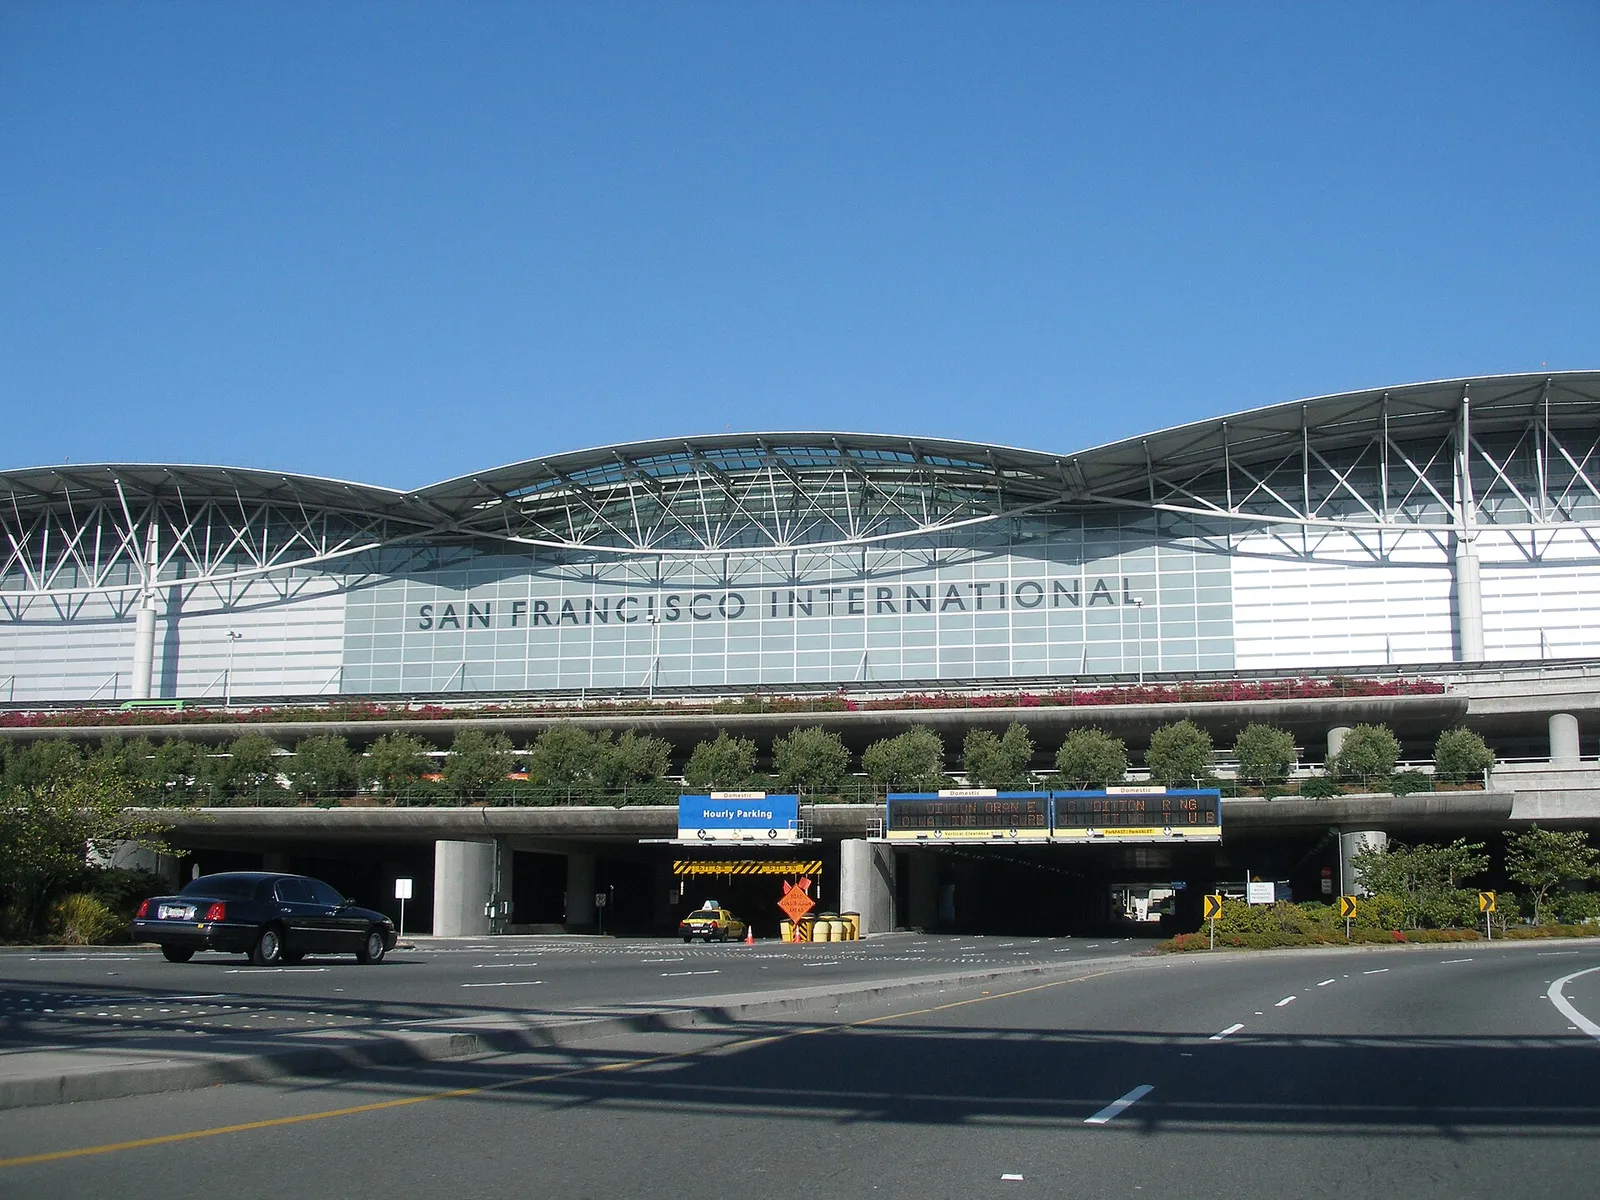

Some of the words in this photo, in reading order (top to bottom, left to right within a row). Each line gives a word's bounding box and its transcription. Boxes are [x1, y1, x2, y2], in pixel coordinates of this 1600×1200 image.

[419, 602, 490, 630] SAN
[512, 593, 746, 626] FRANCISCO
[771, 578, 1136, 618] INTERNATIONAL
[703, 809, 734, 820] Hourly
[736, 809, 773, 819] Parking
